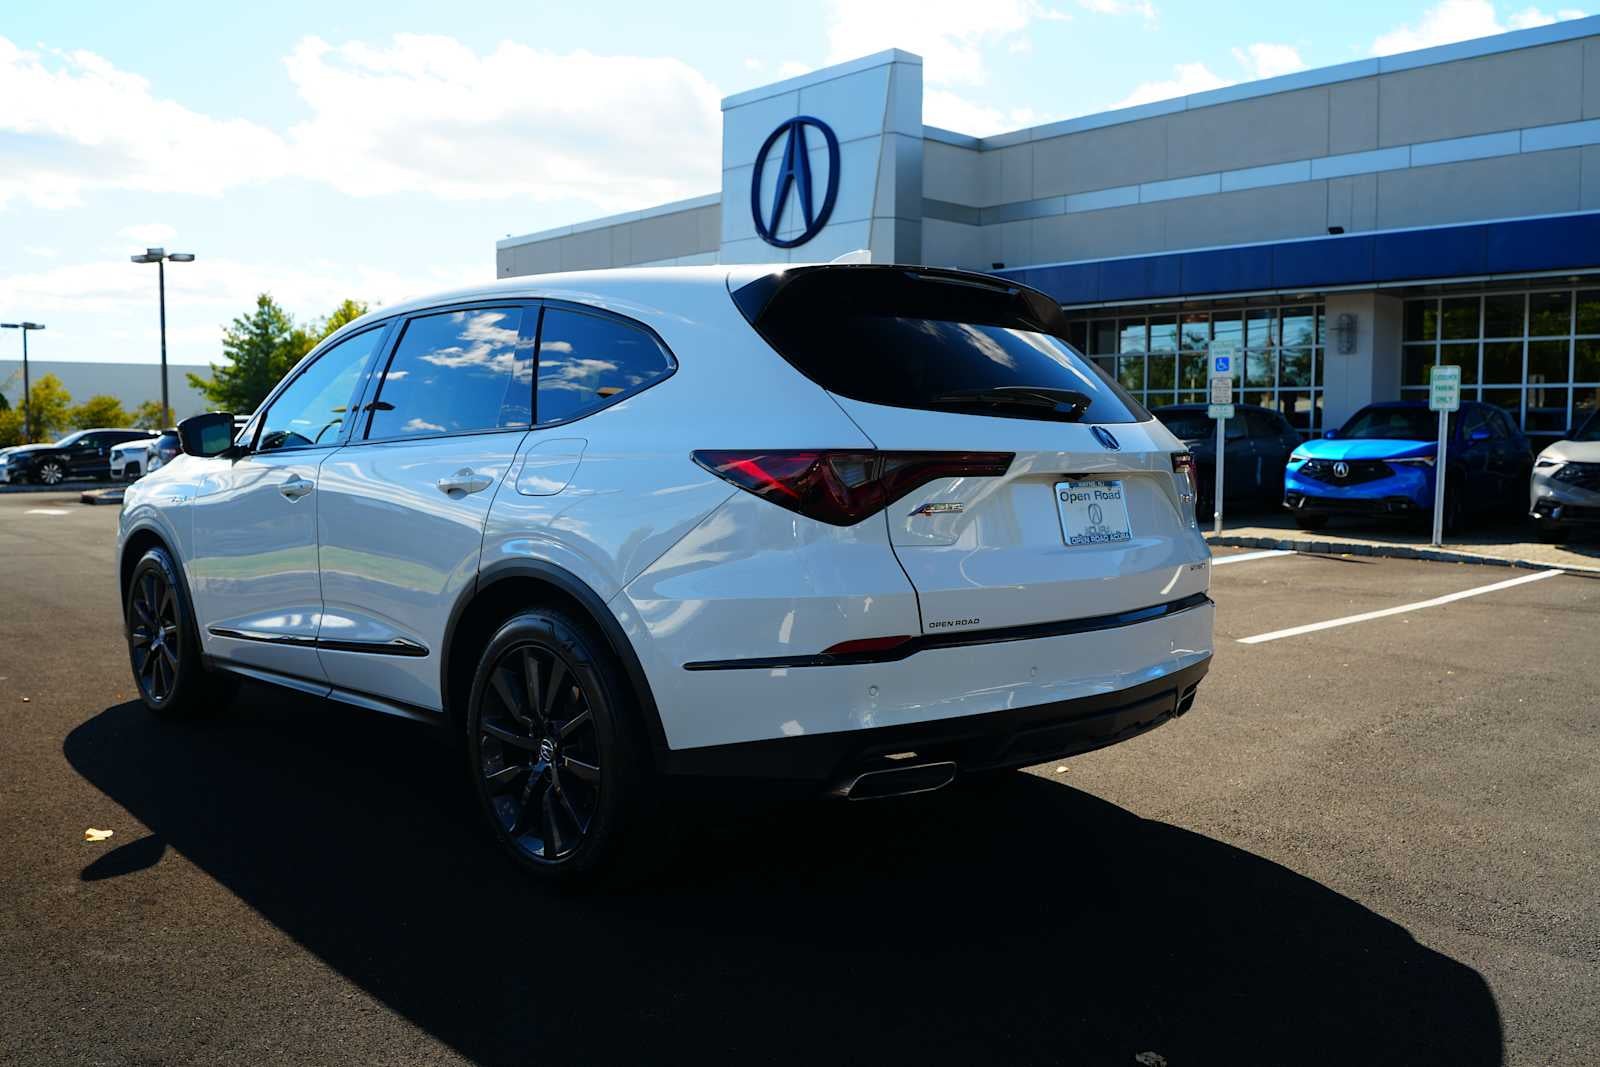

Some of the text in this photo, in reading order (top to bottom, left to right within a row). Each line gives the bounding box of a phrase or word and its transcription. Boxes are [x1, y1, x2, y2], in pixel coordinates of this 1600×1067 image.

[1060, 489, 1121, 503] Open Road
[929, 618, 980, 628] OPEN ROAD
